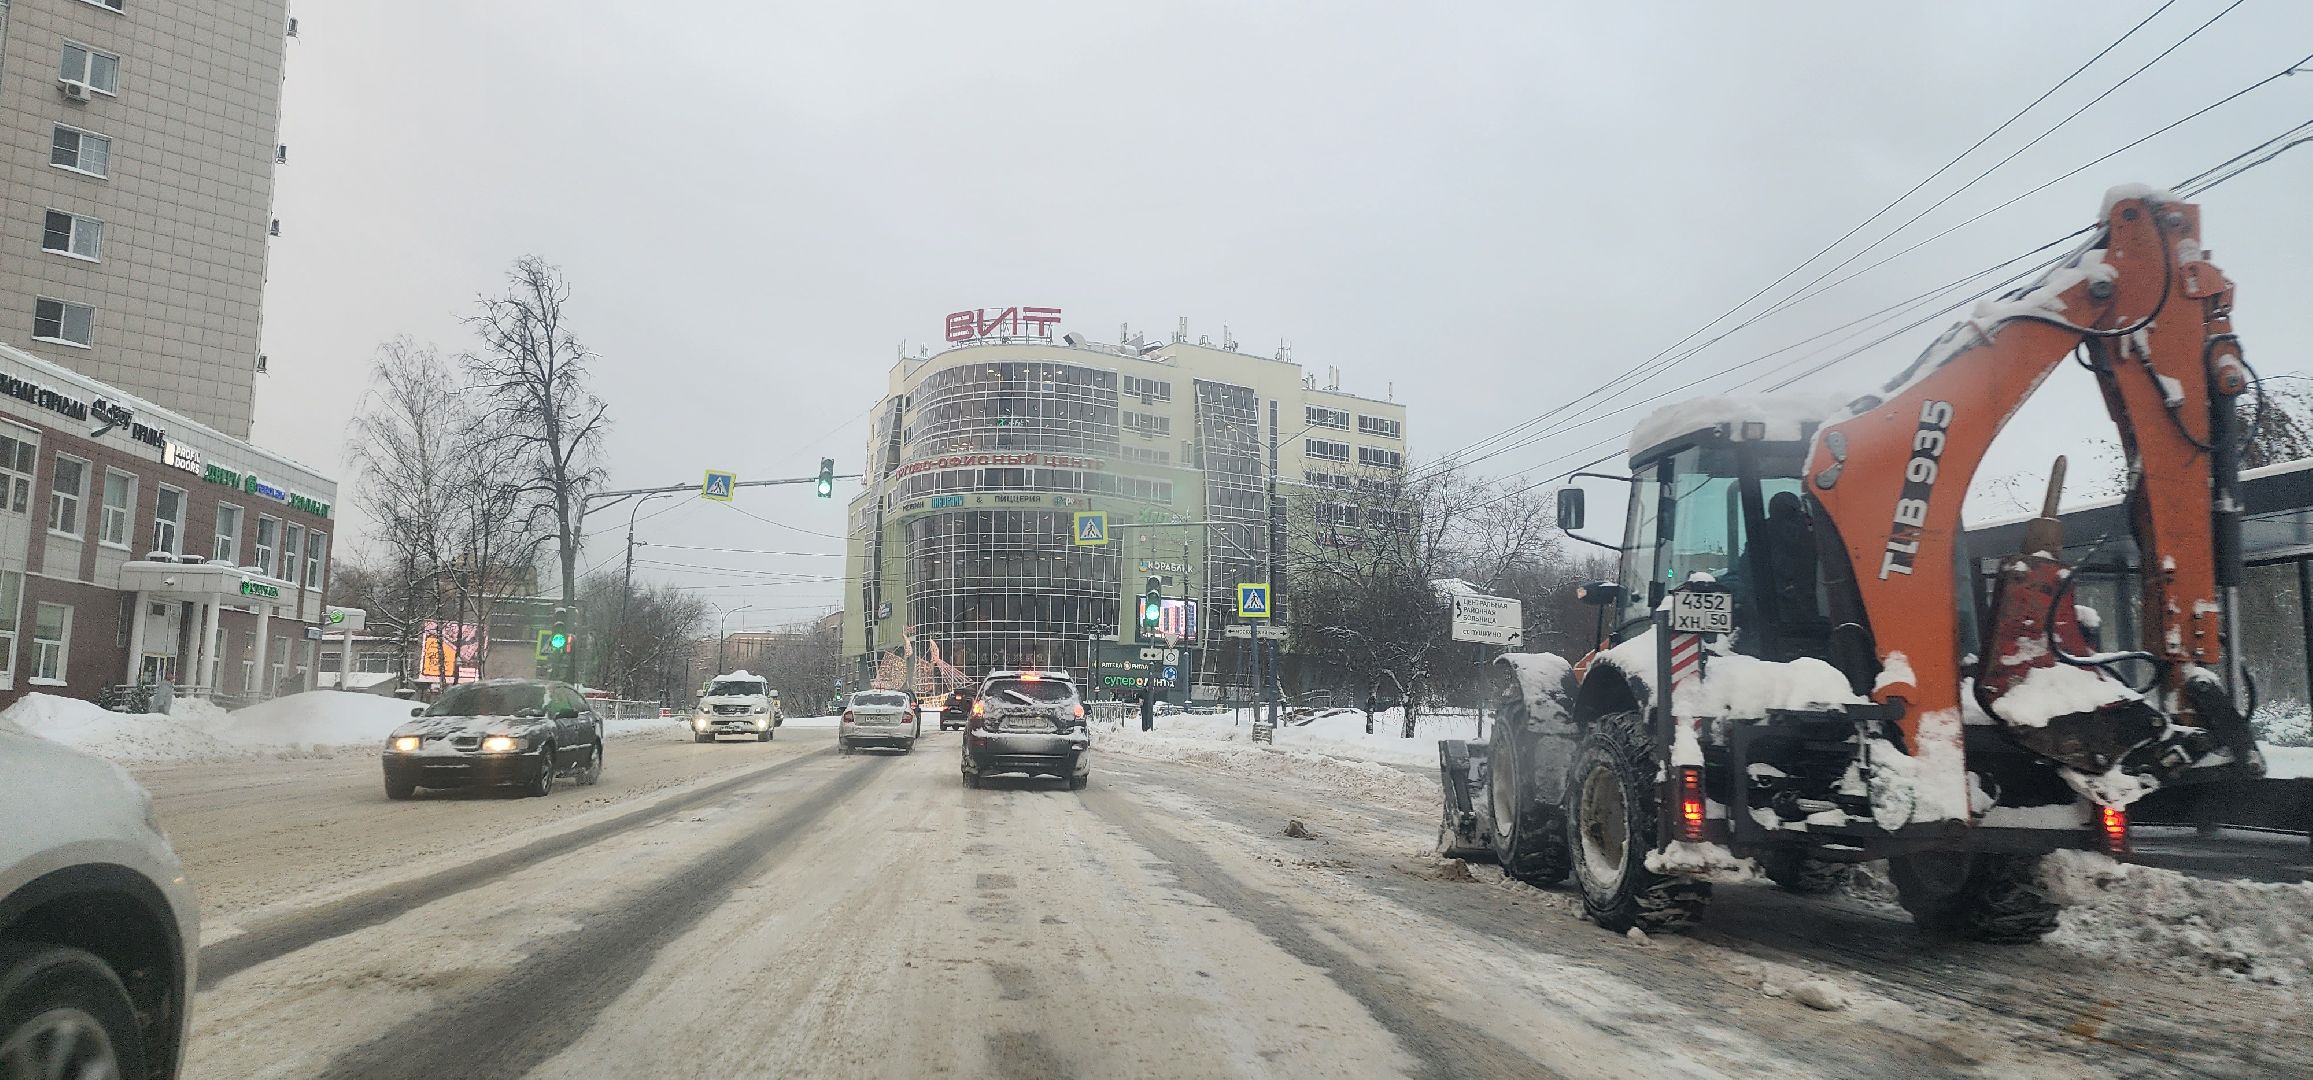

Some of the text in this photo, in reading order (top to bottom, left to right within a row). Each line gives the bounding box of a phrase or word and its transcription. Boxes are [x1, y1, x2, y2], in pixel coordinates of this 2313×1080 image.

[946, 307, 1062, 342] ВИТ
[175, 444, 201, 463] PROFIL
[174, 455, 200, 475] DOORS
[203, 463, 241, 489] ДВЕРИ
[1878, 399, 1954, 580] TLB 935
[994, 494, 1041, 504] ПИЦЦЕРИЯ
[1463, 598, 1508, 610] ЦЕНТРАЛЬНАЯ
[1682, 594, 1725, 610] 4352
[1463, 606, 1497, 616] РАЙОННАЯ
[1463, 614, 1497, 624] БОЛЬНИЦА
[1710, 613, 1728, 625] 50
